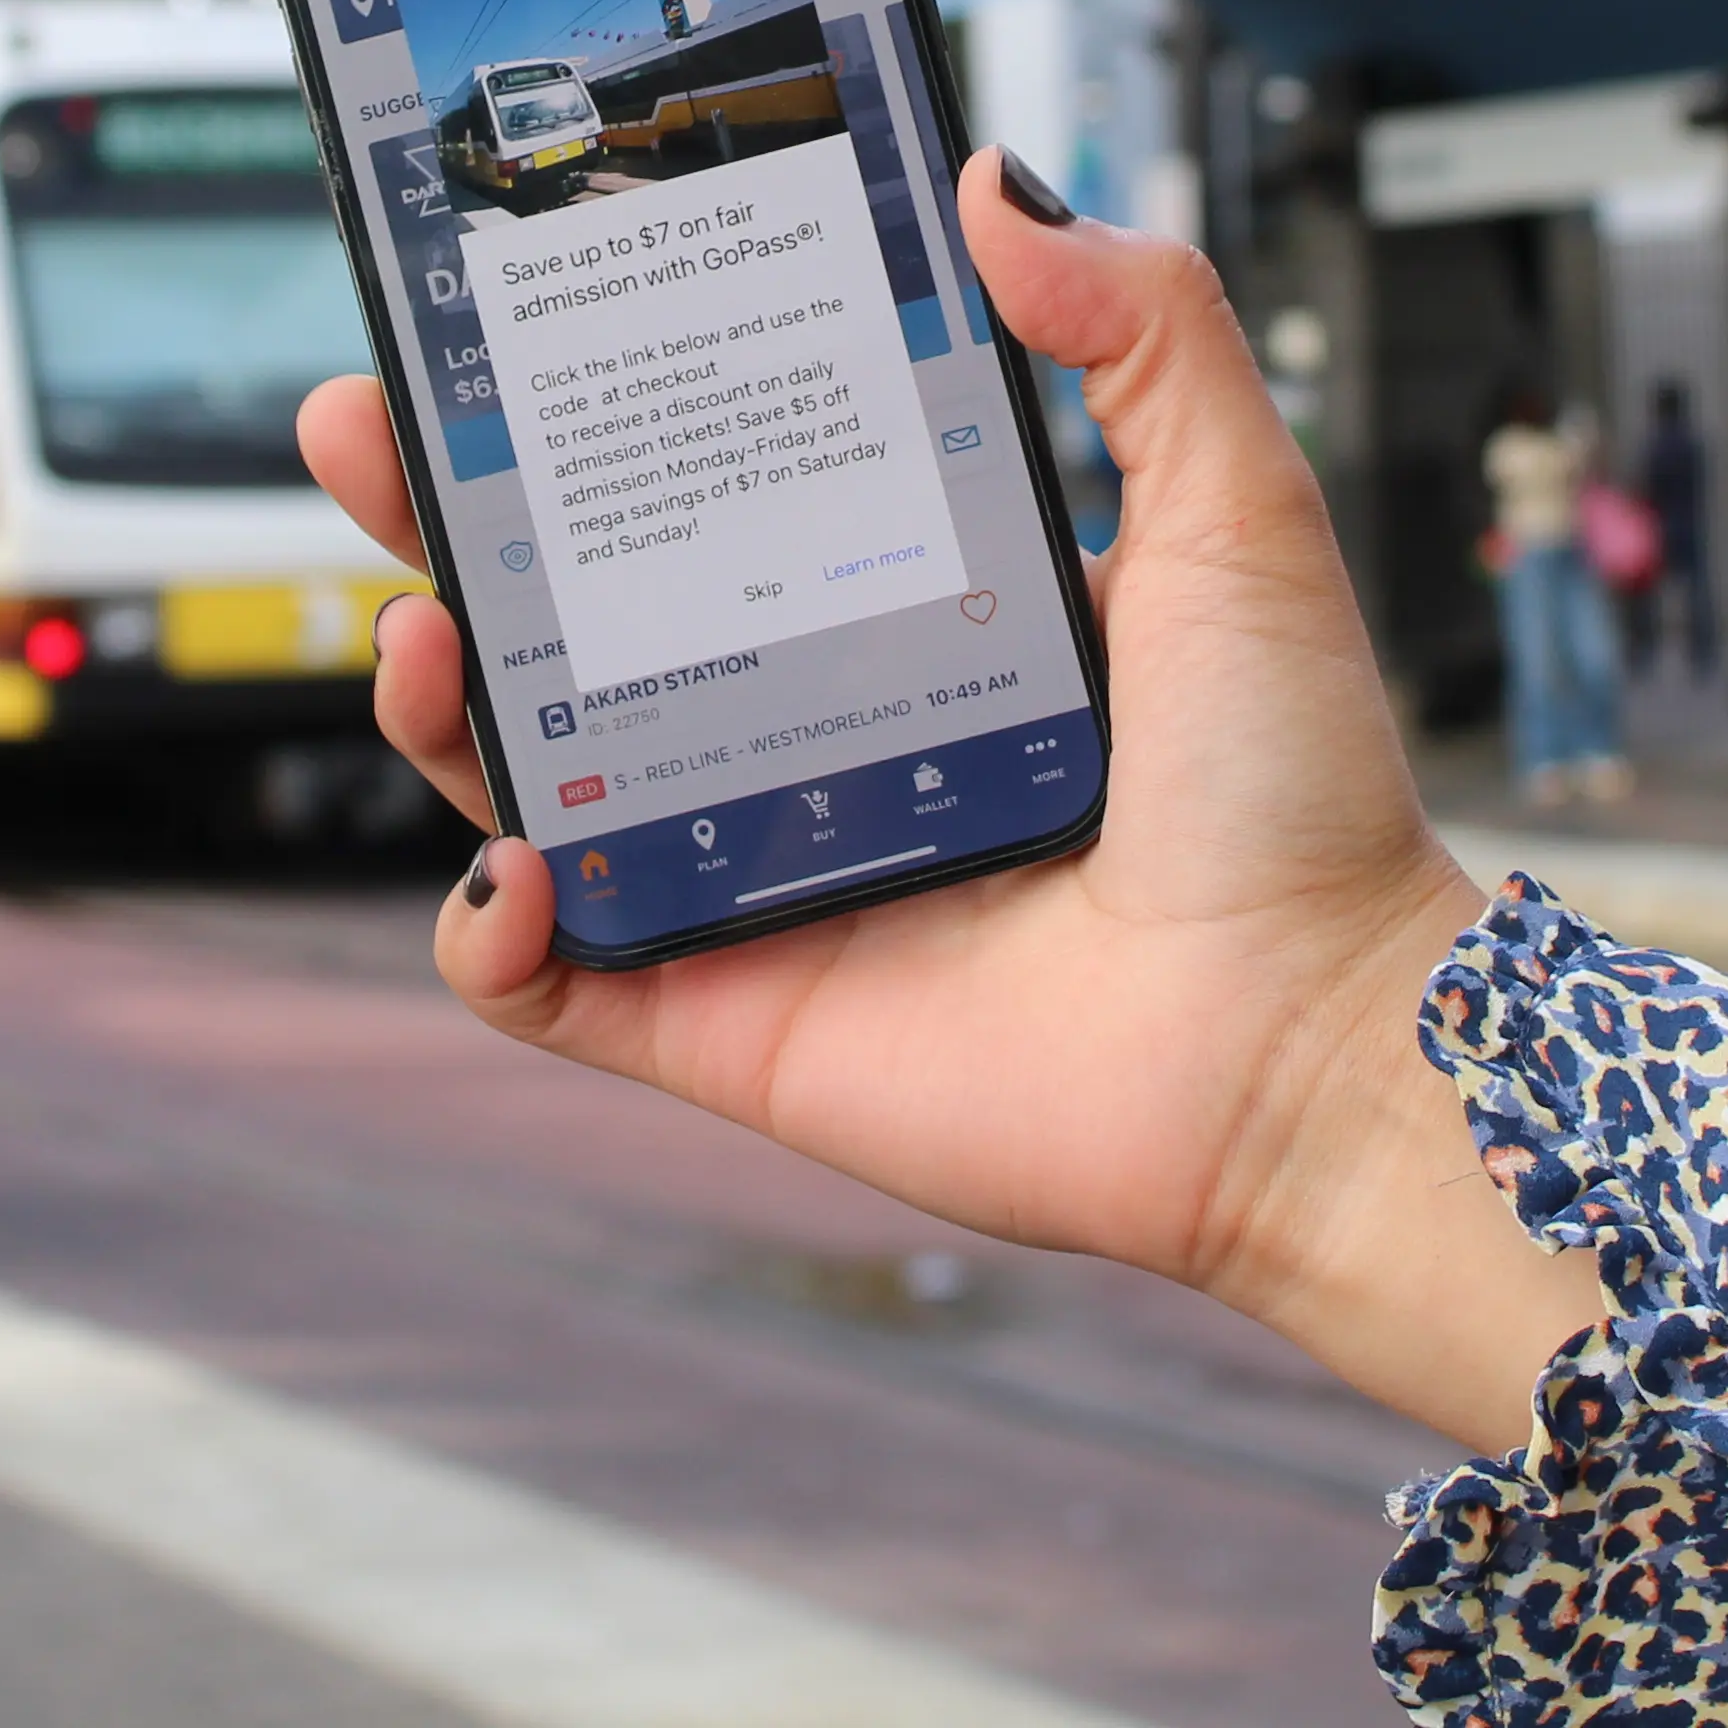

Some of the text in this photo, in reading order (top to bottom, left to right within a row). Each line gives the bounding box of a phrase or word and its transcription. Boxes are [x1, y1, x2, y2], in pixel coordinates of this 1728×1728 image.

[401, 179, 445, 204] DAR
[502, 201, 754, 285] Save up to $7 on fair
[512, 277, 639, 322] admission
[644, 256, 697, 286] with
[531, 298, 844, 392] Click the link below and use the
[538, 360, 719, 421] code at checkout
[545, 360, 834, 450] to receive a discount on daily
[554, 384, 850, 479] admission tickets! Save $5 off
[561, 412, 861, 508] admission Monday-Friday and
[569, 440, 886, 537] mega savings of $7 on Saturday
[576, 517, 700, 565] and Sunday!
[822, 544, 926, 582] Learn more
[743, 581, 784, 603] Skip
[582, 650, 760, 713] AKARD STATION
[588, 722, 610, 737] ID:
[614, 773, 627, 790] S
[645, 759, 684, 782] RED
[688, 746, 732, 771] LINE
[749, 699, 912, 755] WESTMORELAND
[926, 680, 982, 708] 10:49
[988, 670, 1019, 693] AM
[566, 782, 598, 801] RED
[1032, 768, 1066, 785] MORE
[913, 796, 959, 816] WALLET
[812, 827, 836, 843] BUY
[697, 856, 728, 872] PLAN
